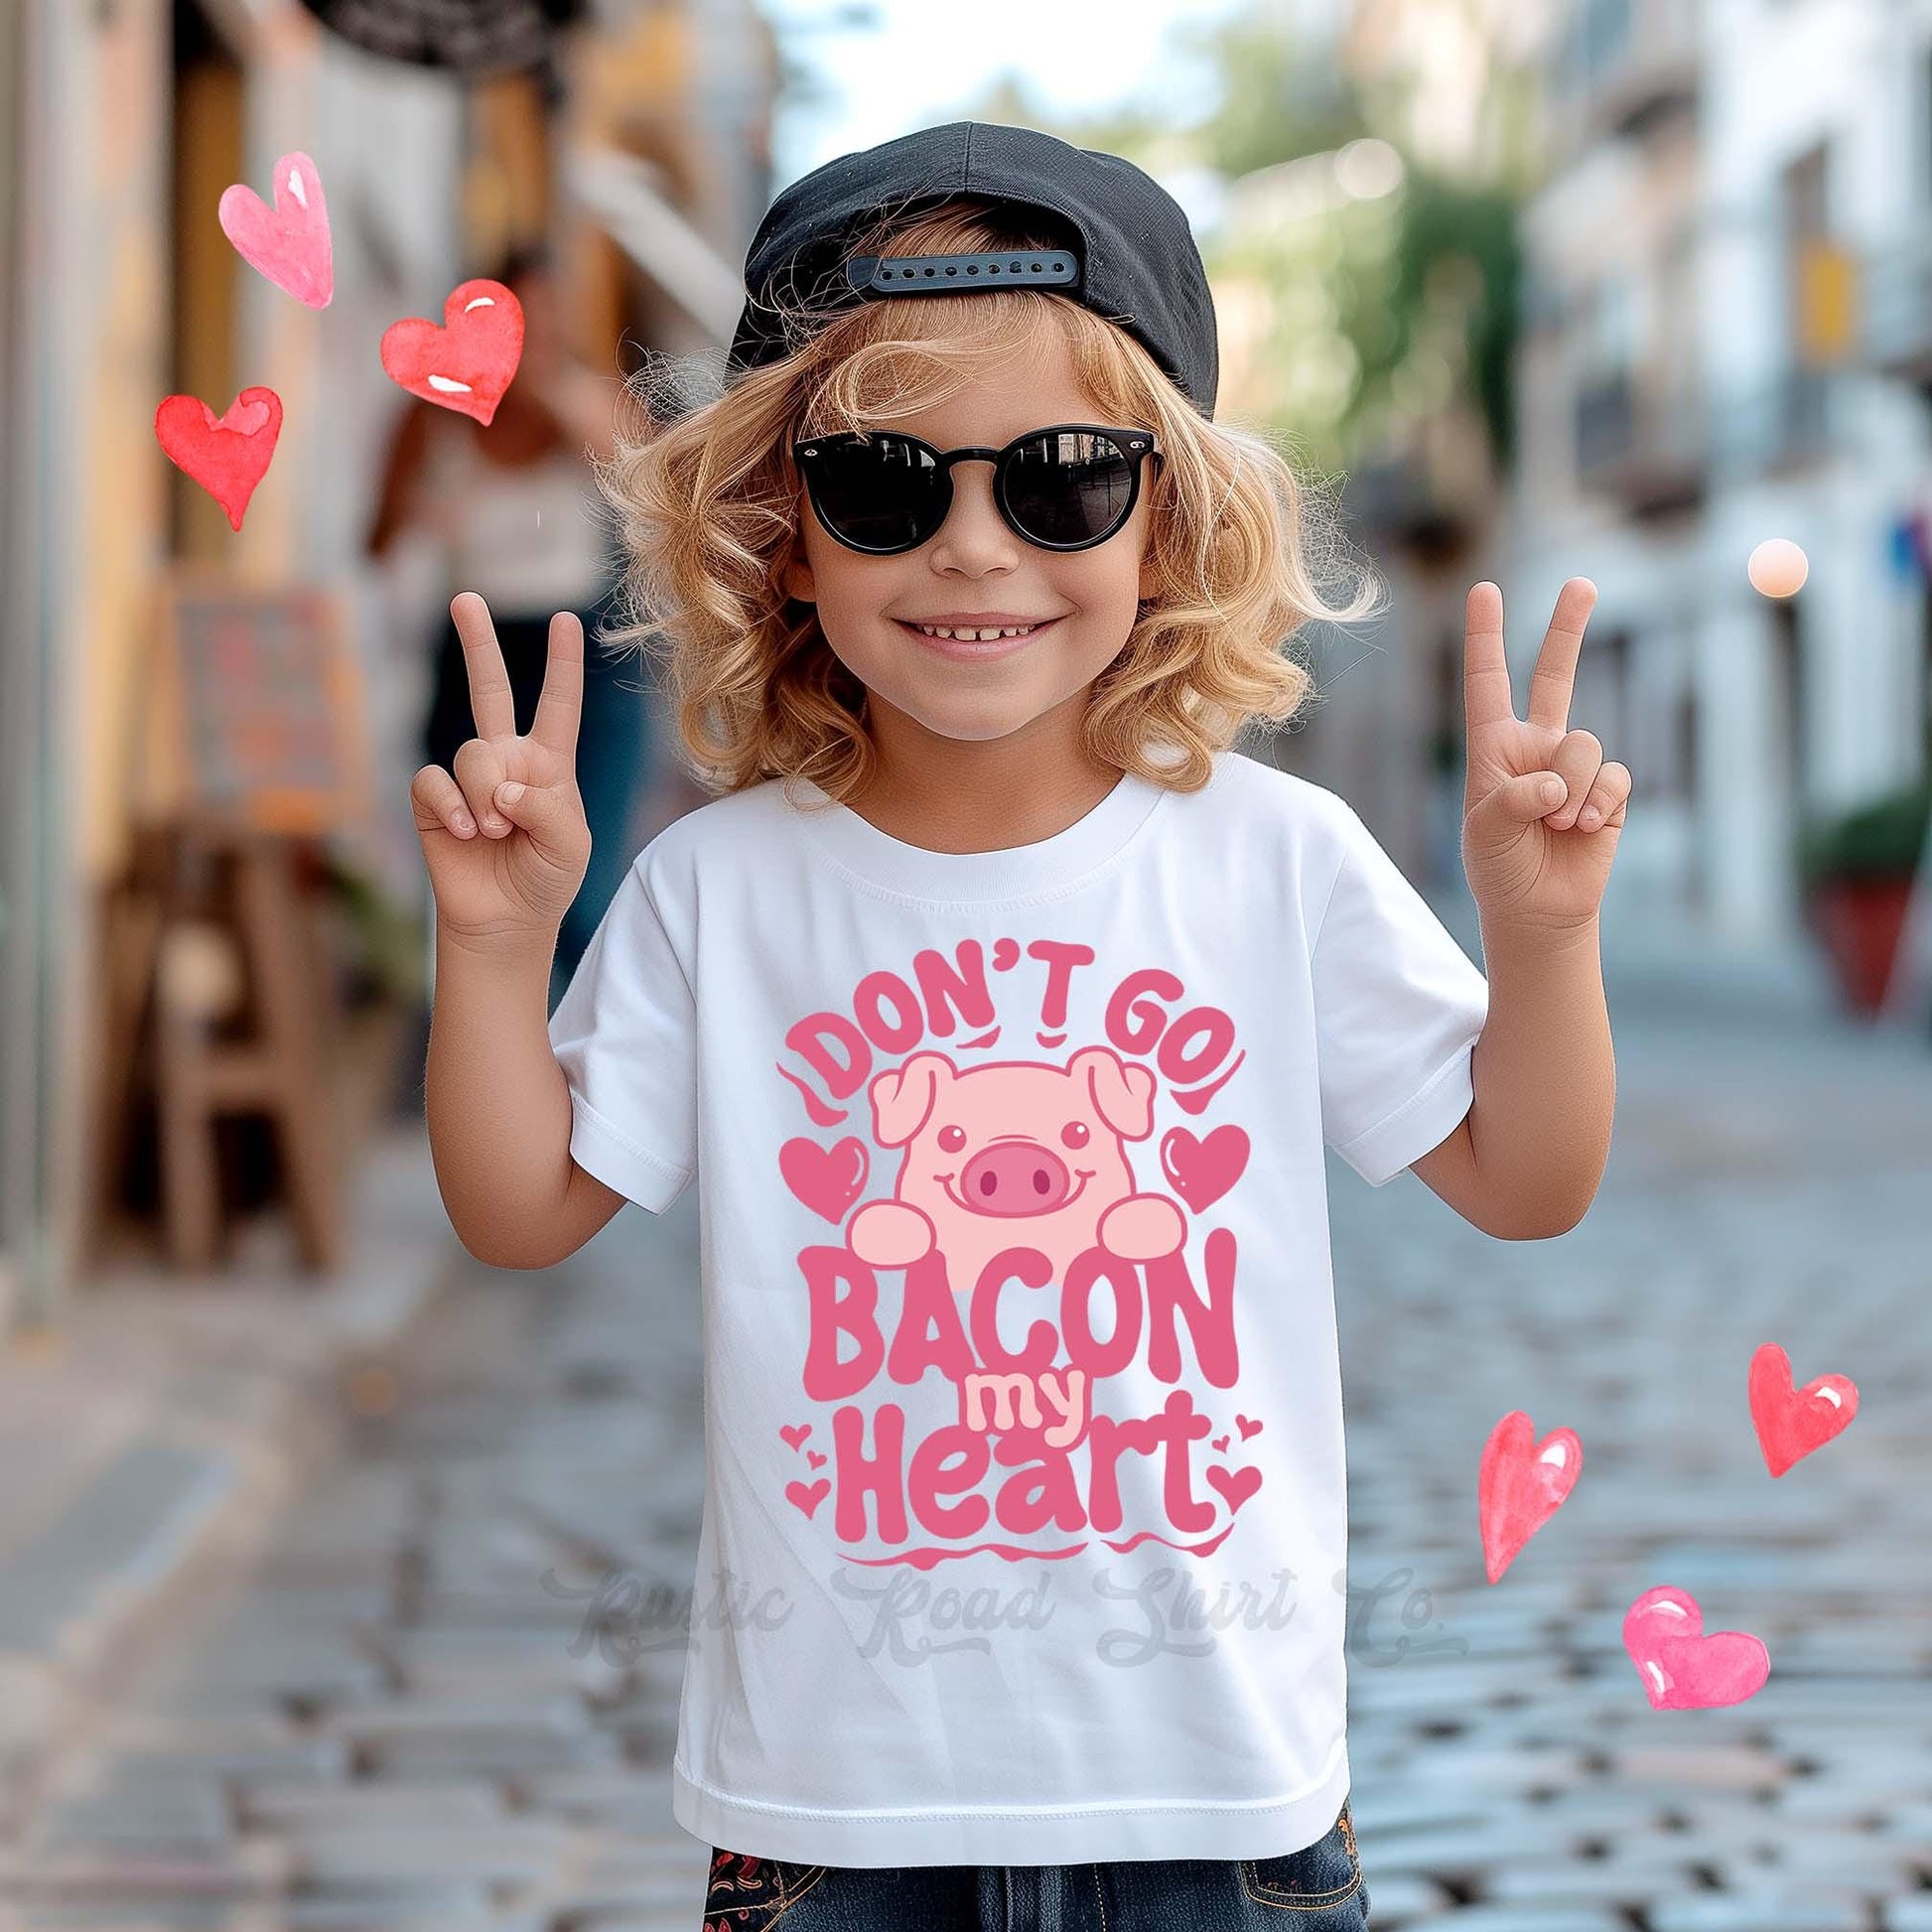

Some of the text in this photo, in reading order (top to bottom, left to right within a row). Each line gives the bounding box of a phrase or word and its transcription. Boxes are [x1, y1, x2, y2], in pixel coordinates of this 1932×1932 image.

[785, 938, 1235, 1100] DON'T GO
[797, 1228, 1240, 1402] BACON
[832, 1390, 1216, 1545] Heart
[964, 1370, 1086, 1449] my
